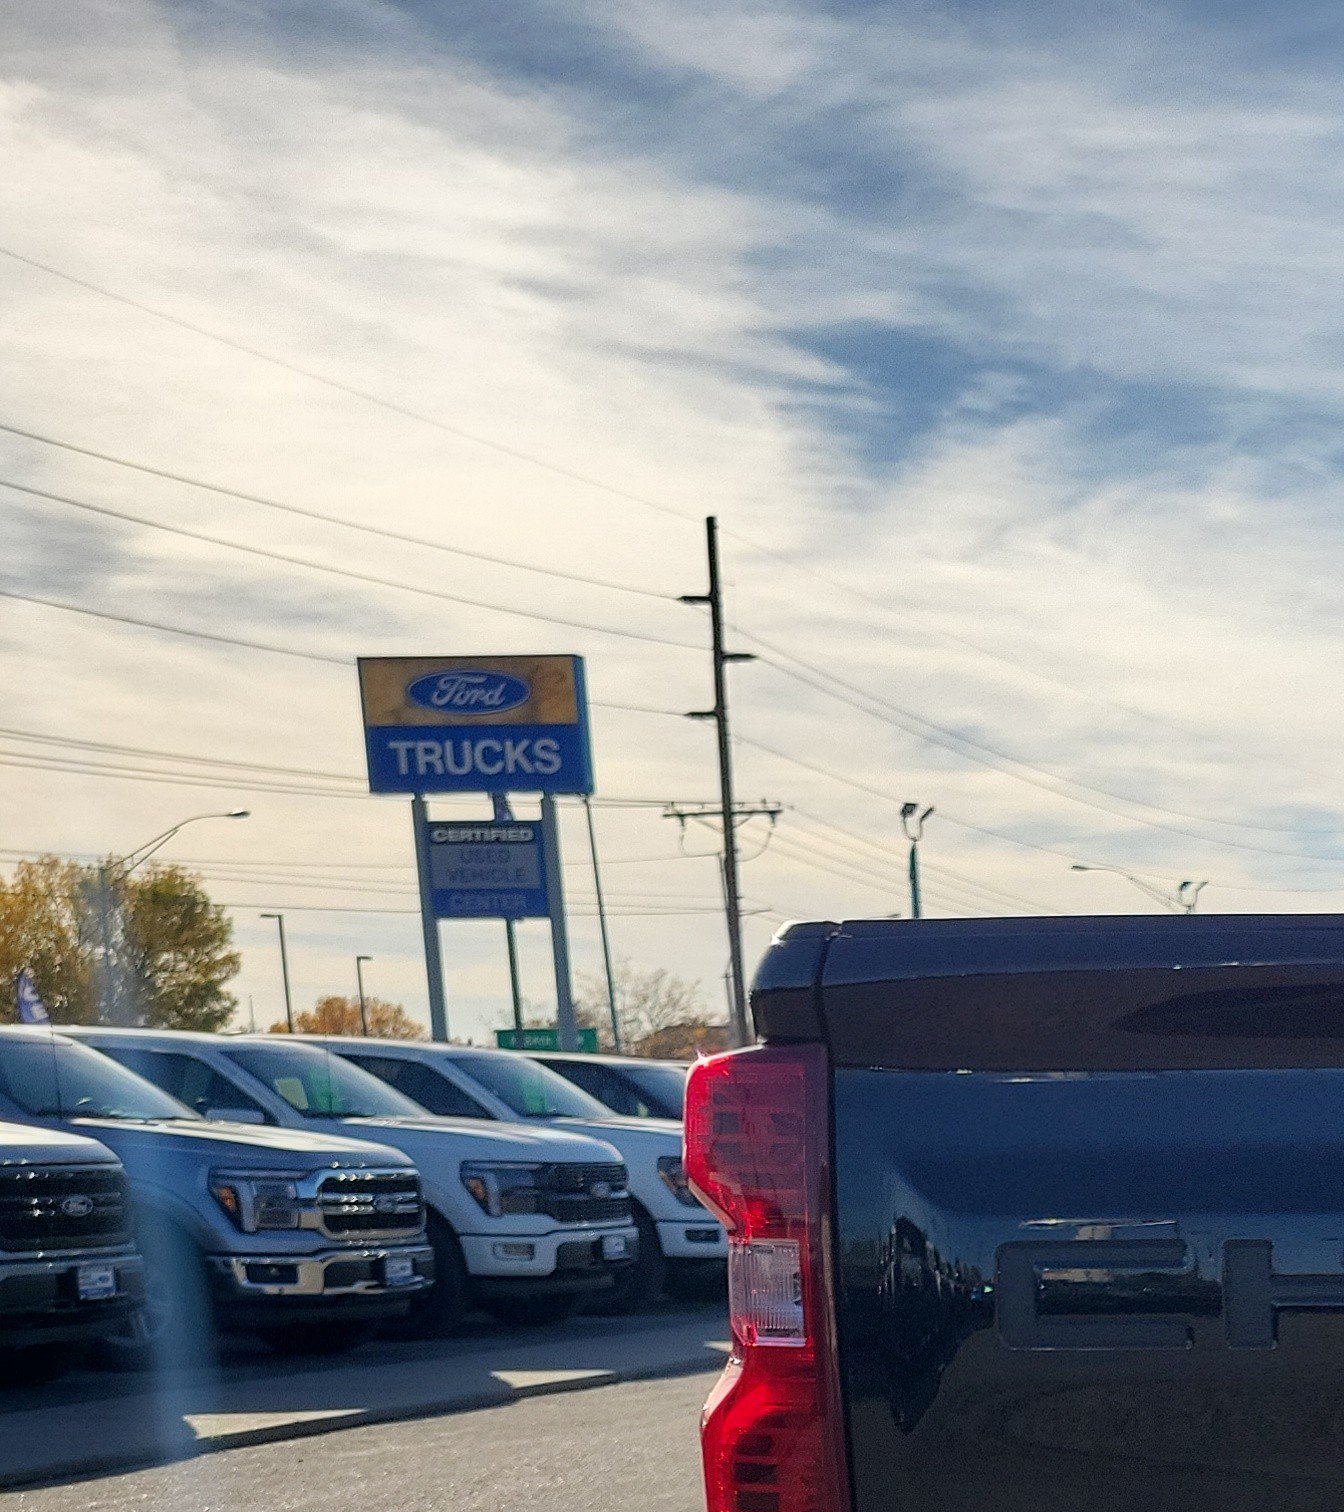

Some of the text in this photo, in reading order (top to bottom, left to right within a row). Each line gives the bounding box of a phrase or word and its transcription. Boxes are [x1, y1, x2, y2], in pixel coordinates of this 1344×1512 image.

[431, 674, 507, 709] Ford
[388, 739, 562, 776] TRUCKS
[431, 826, 535, 843] CERTIFIED
